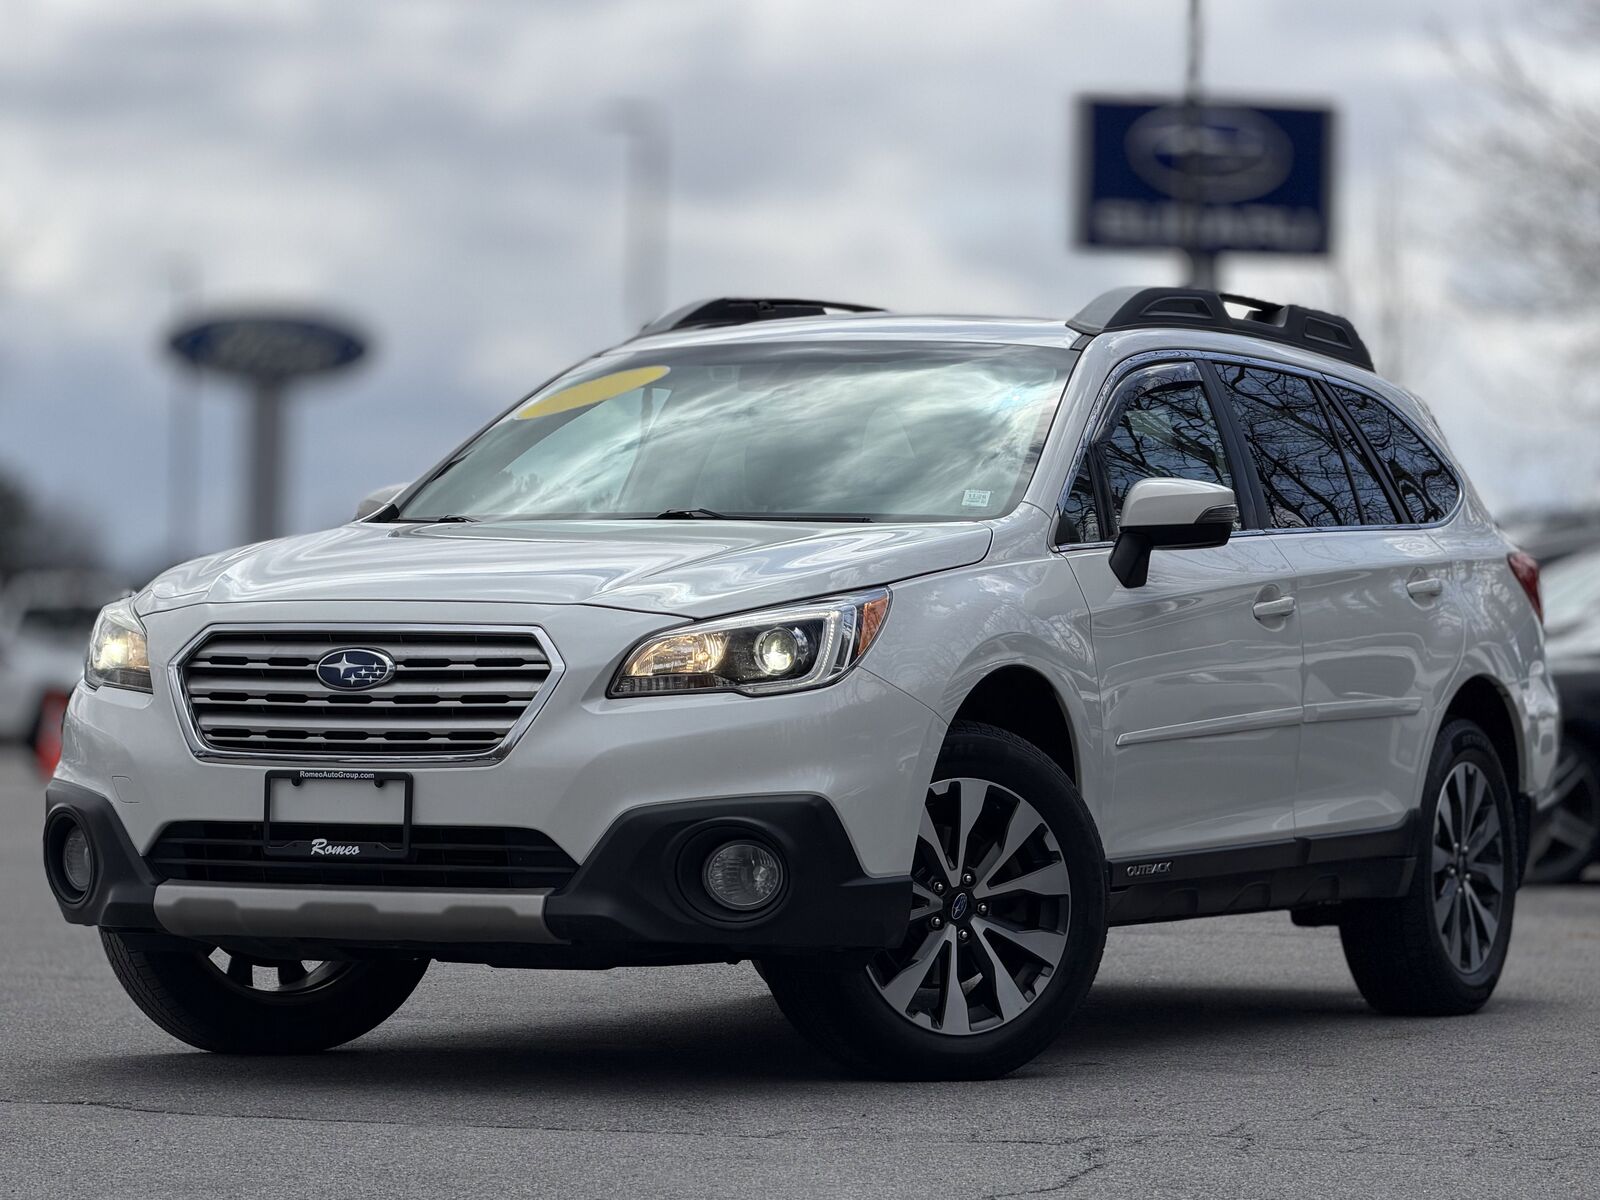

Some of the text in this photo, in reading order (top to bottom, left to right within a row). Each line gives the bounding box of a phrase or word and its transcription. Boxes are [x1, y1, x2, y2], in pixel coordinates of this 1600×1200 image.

[299, 770, 375, 779] RomeoAutoGroup.com
[310, 838, 361, 856] Romeo
[1126, 862, 1172, 877] OUTBACK
